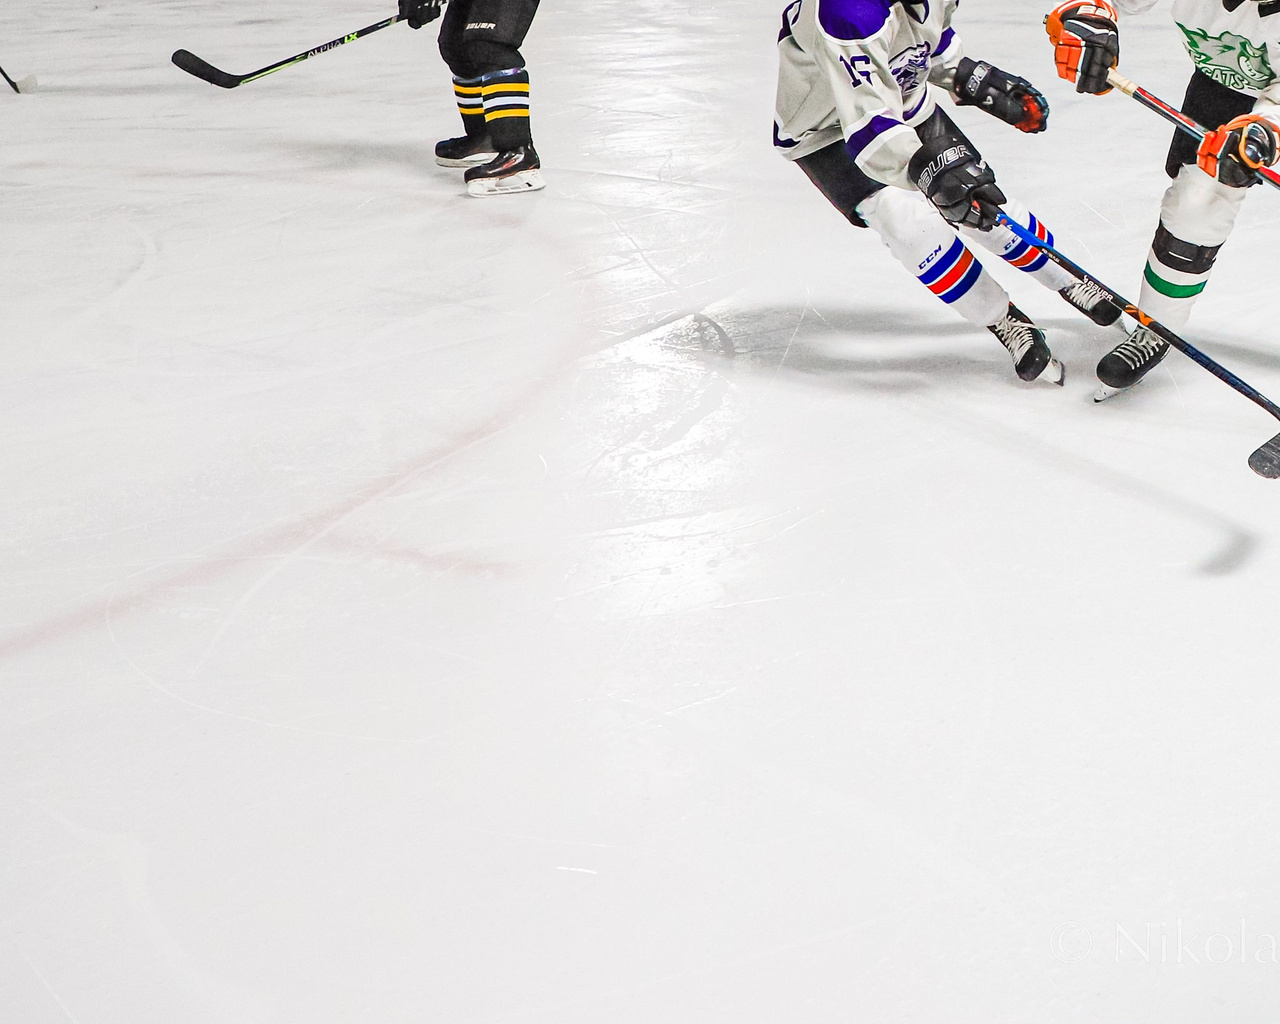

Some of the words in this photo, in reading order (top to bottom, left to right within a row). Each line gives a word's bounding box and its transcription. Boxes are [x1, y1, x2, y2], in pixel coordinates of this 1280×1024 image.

[307, 38, 342, 59] ALPHA
[343, 31, 359, 44] LX
[1003, 235, 1020, 251] CC
[917, 244, 943, 270] CCM
[1086, 280, 1114, 302] BAUER
